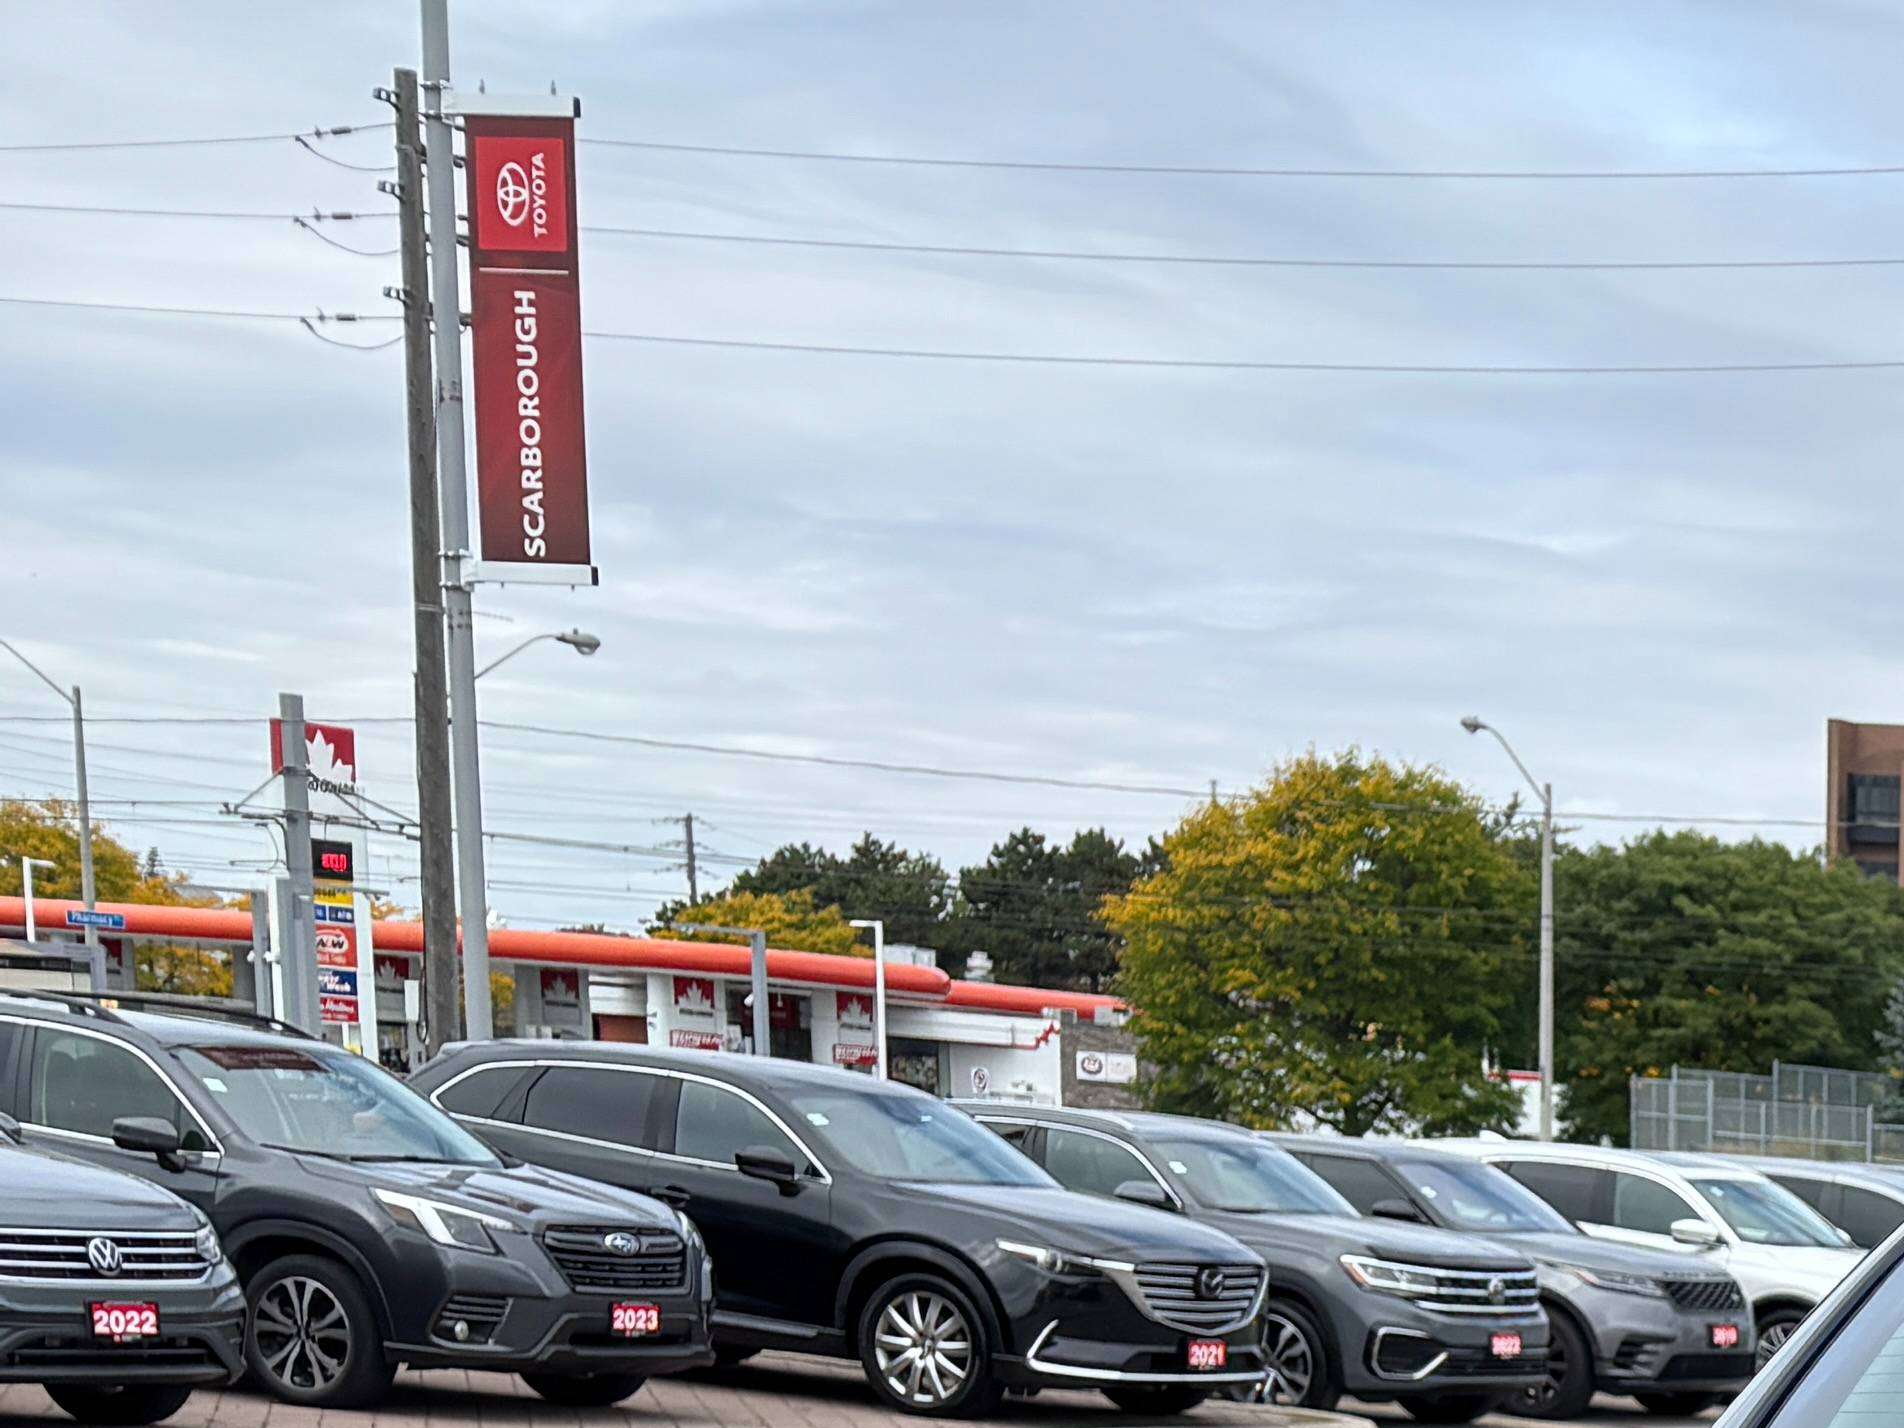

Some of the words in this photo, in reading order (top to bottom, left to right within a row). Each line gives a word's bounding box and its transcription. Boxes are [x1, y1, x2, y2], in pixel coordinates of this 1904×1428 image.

[532, 152, 547, 237] TOYOTA
[514, 290, 547, 557] SCARBOROUGH
[93, 1309, 158, 1335] 2022
[612, 1308, 659, 1331] 2023
[1190, 1343, 1224, 1366] 2021
